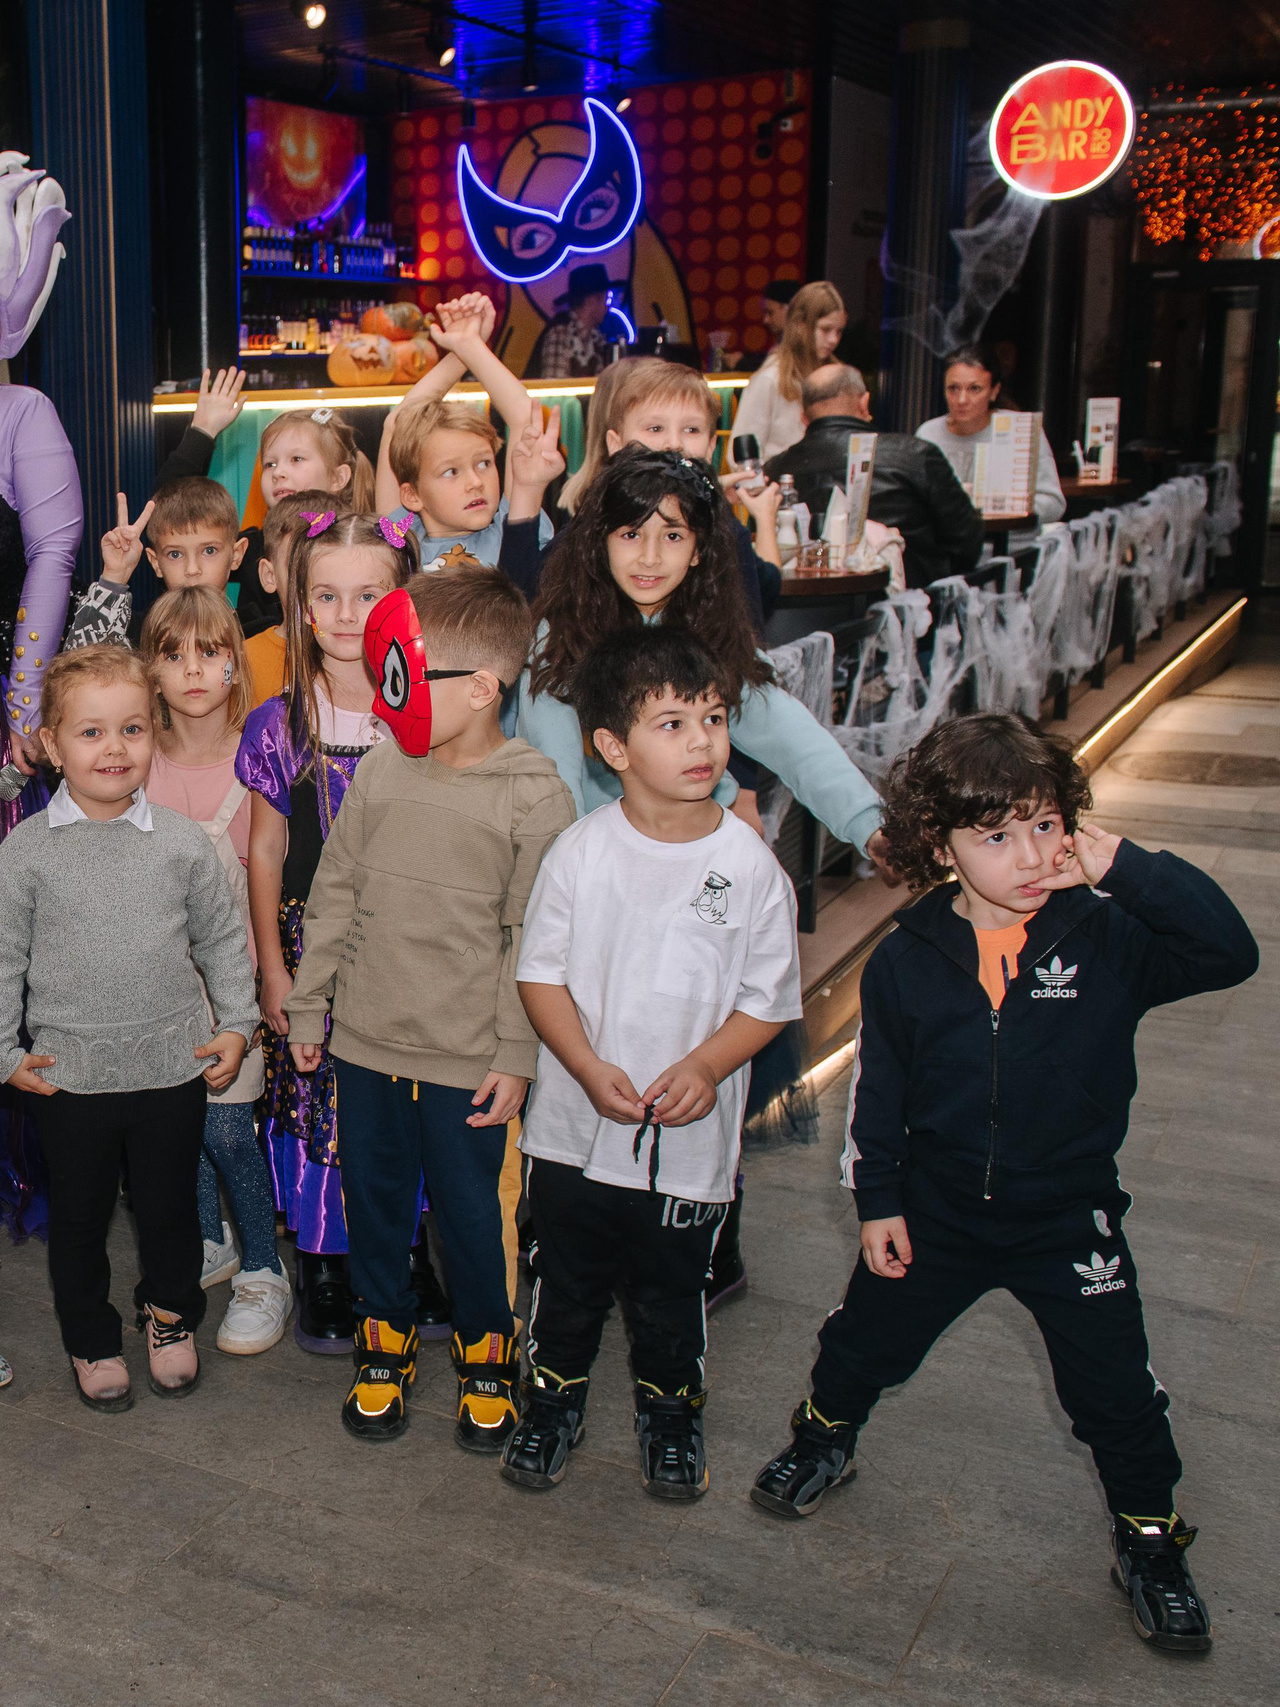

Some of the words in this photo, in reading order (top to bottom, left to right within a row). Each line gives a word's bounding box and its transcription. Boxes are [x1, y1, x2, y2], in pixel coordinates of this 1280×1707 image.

[1011, 96, 1113, 134] ANDY
[1010, 131, 1087, 165] BAR
[1031, 987, 1077, 998] adidas
[1081, 1279, 1126, 1296] adidas
